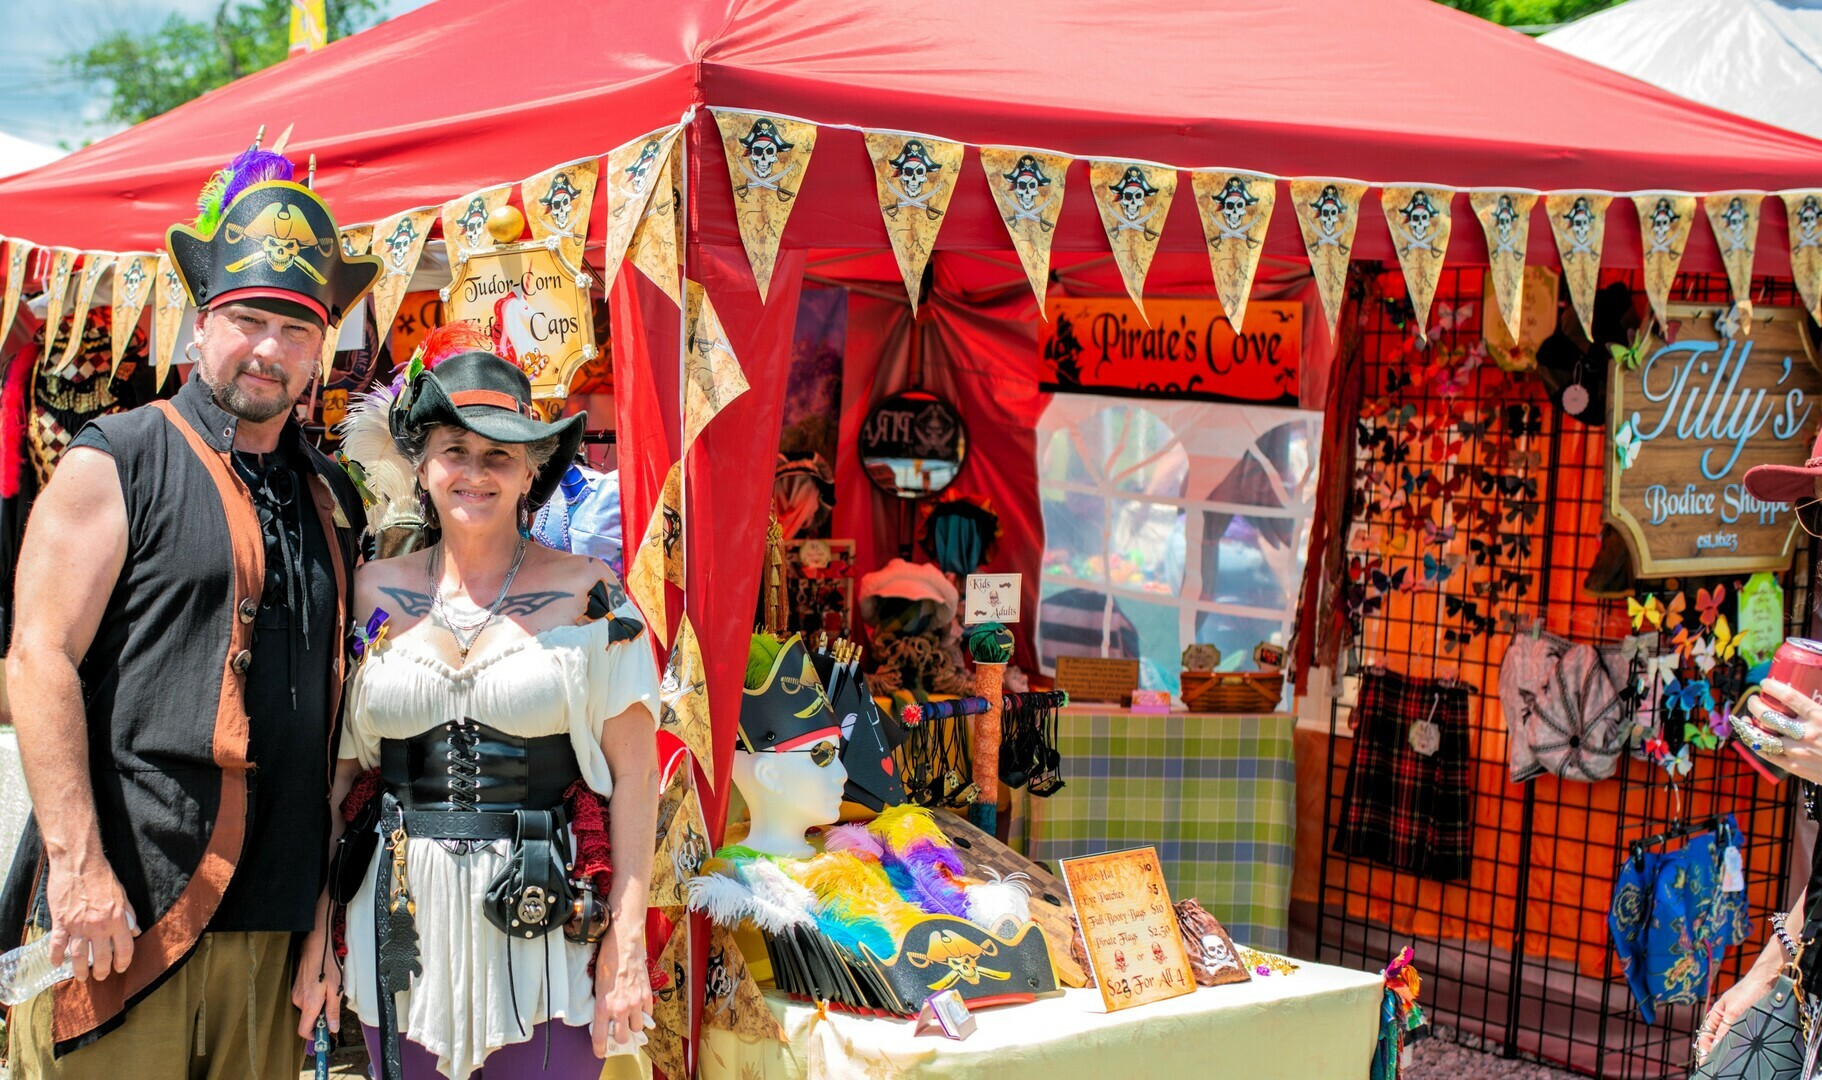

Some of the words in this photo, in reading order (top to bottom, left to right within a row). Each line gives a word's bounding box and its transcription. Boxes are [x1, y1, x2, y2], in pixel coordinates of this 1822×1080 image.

[464, 271, 562, 303] Tudor-Corn
[463, 316, 502, 351] ids
[530, 312, 579, 345] Caps
[1091, 312, 1198, 379] Pirate's
[1205, 315, 1282, 376] Cove
[1631, 339, 1813, 480] Tilly's
[1645, 483, 1716, 526] Bodice
[969, 578, 991, 593] Kids
[990, 605, 1017, 620] Adults
[1082, 895, 1096, 908] Eye
[1097, 889, 1125, 903] Patches
[1089, 914, 1104, 929] Full
[1128, 909, 1146, 921] Bags
[1150, 903, 1164, 915] $10
[1094, 936, 1117, 949] Pirate
[1118, 932, 1138, 946] Flags
[1147, 925, 1171, 938] $2.50
[1136, 953, 1145, 961] or
[1131, 974, 1154, 995] For
[1159, 968, 1174, 988] All
[1176, 968, 1186, 987] 4
